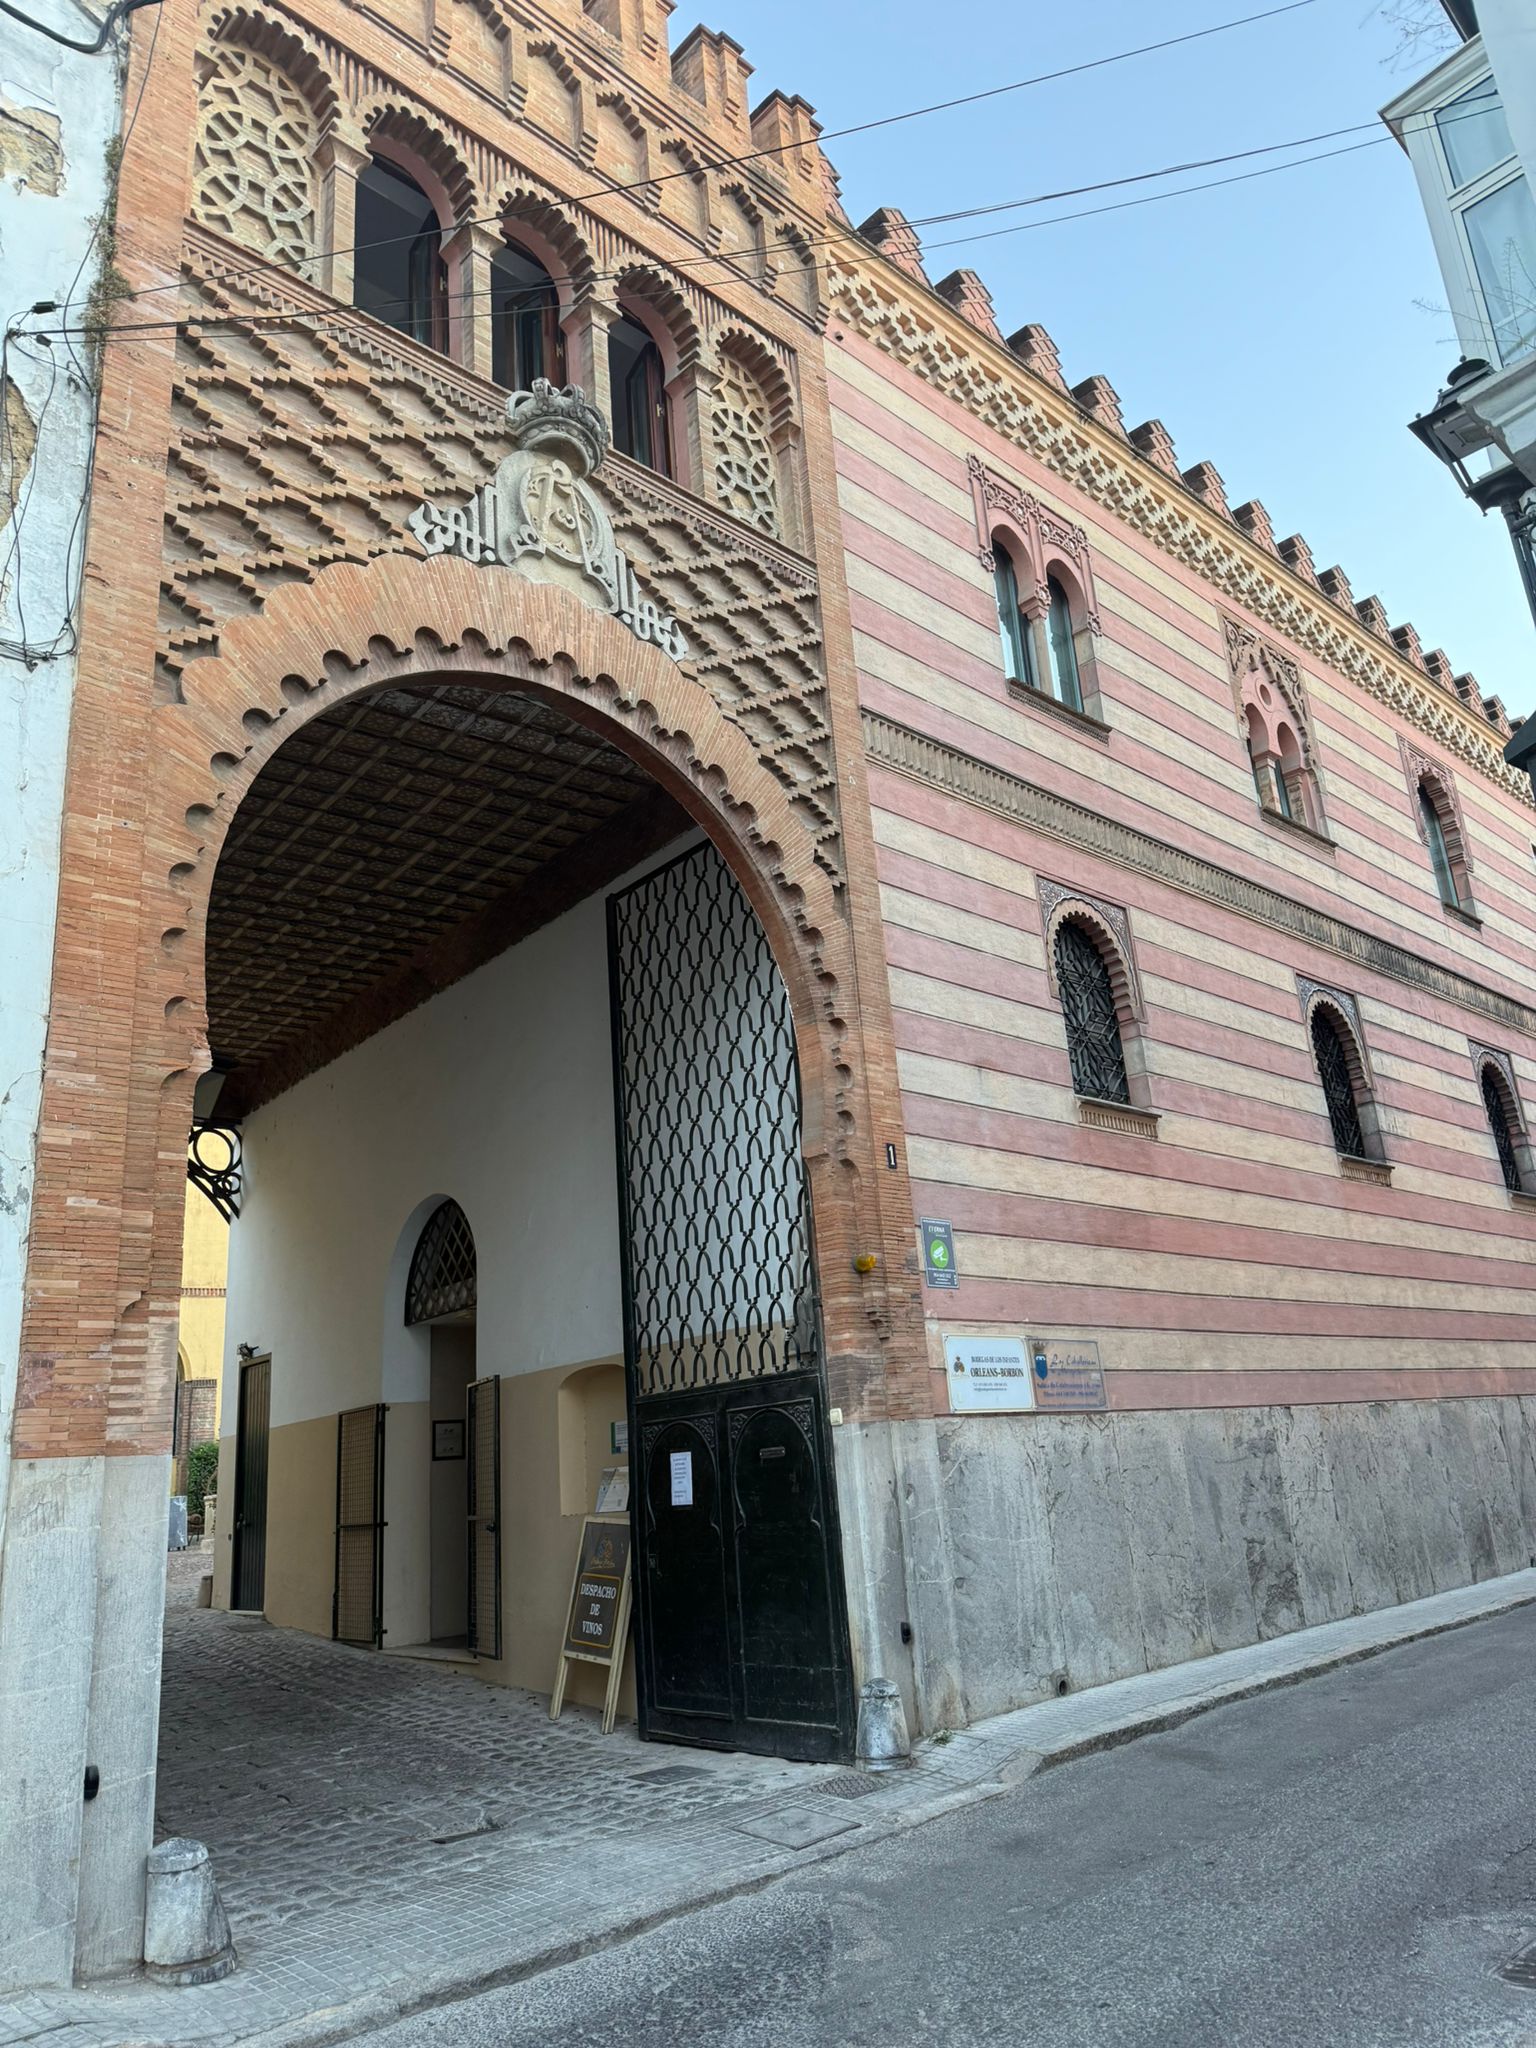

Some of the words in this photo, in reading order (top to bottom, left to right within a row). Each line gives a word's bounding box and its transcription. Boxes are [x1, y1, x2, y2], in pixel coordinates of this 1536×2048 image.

[888, 1145, 895, 1166] 1
[970, 1367, 1024, 1378] ORLEANS-BORBON
[580, 1583, 617, 1600] DESPACHO
[589, 1603, 601, 1616] DE
[582, 1620, 603, 1636] VINOS
